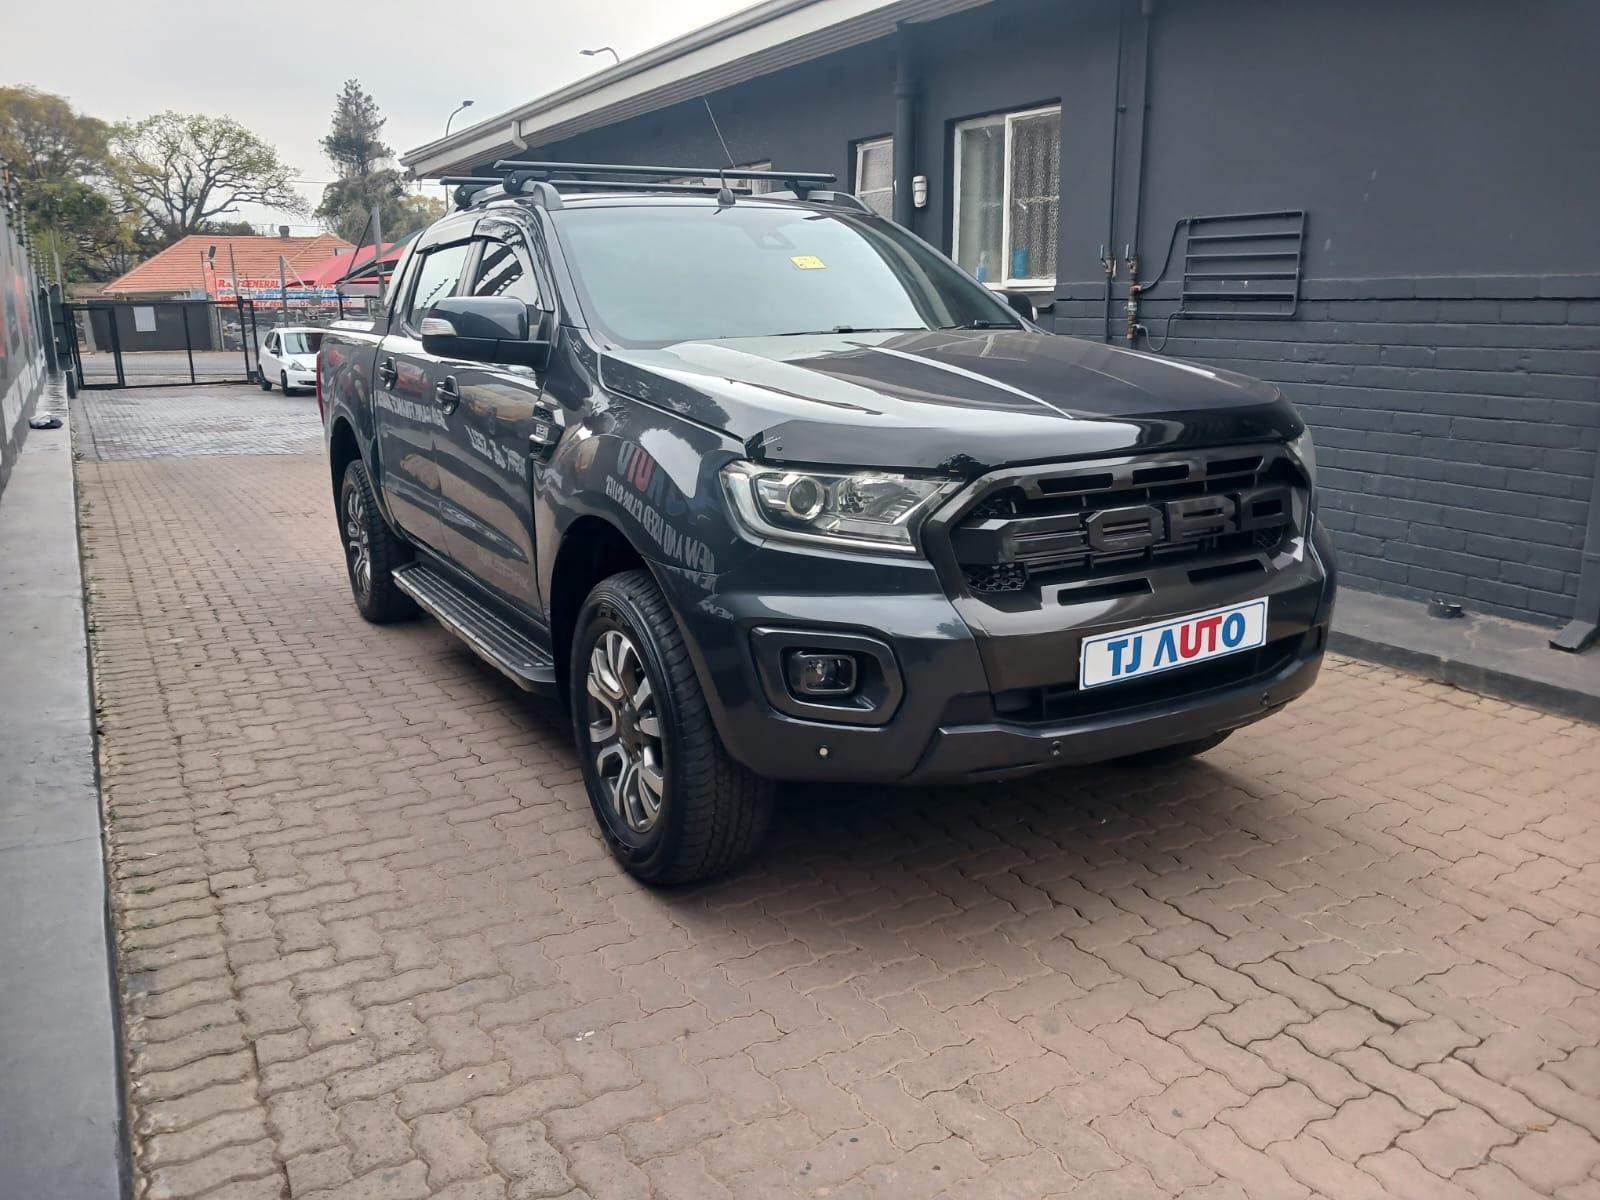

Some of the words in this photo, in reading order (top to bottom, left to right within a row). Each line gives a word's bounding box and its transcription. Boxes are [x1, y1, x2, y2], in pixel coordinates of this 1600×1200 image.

[958, 485, 1292, 566] FORD
[1107, 637, 1142, 677] TJ
[1153, 612, 1246, 667] AUTO
